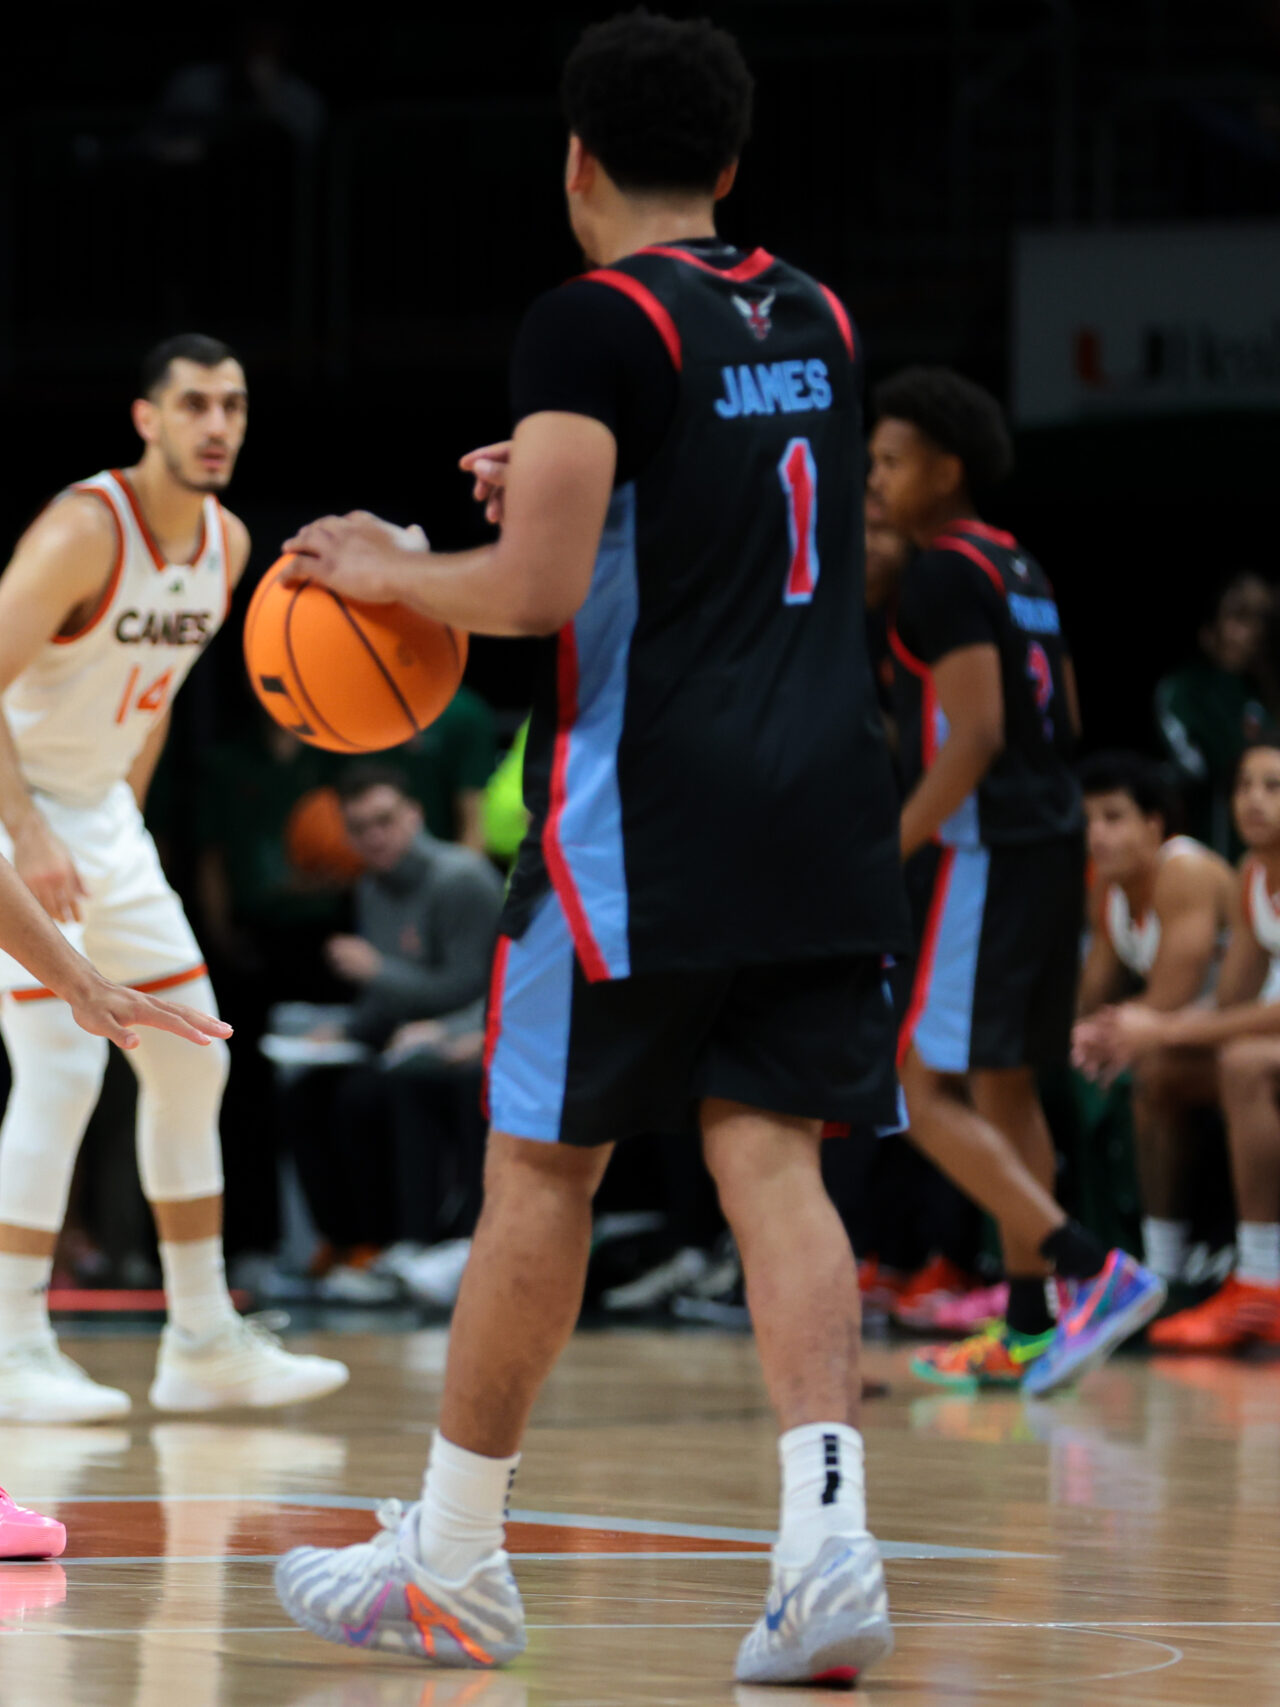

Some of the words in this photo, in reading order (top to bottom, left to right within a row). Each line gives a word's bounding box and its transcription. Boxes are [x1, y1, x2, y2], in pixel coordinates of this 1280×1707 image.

[713, 358, 833, 420] JAMES
[776, 436, 821, 606] 1
[115, 610, 213, 645] CANES
[116, 665, 174, 725] 14
